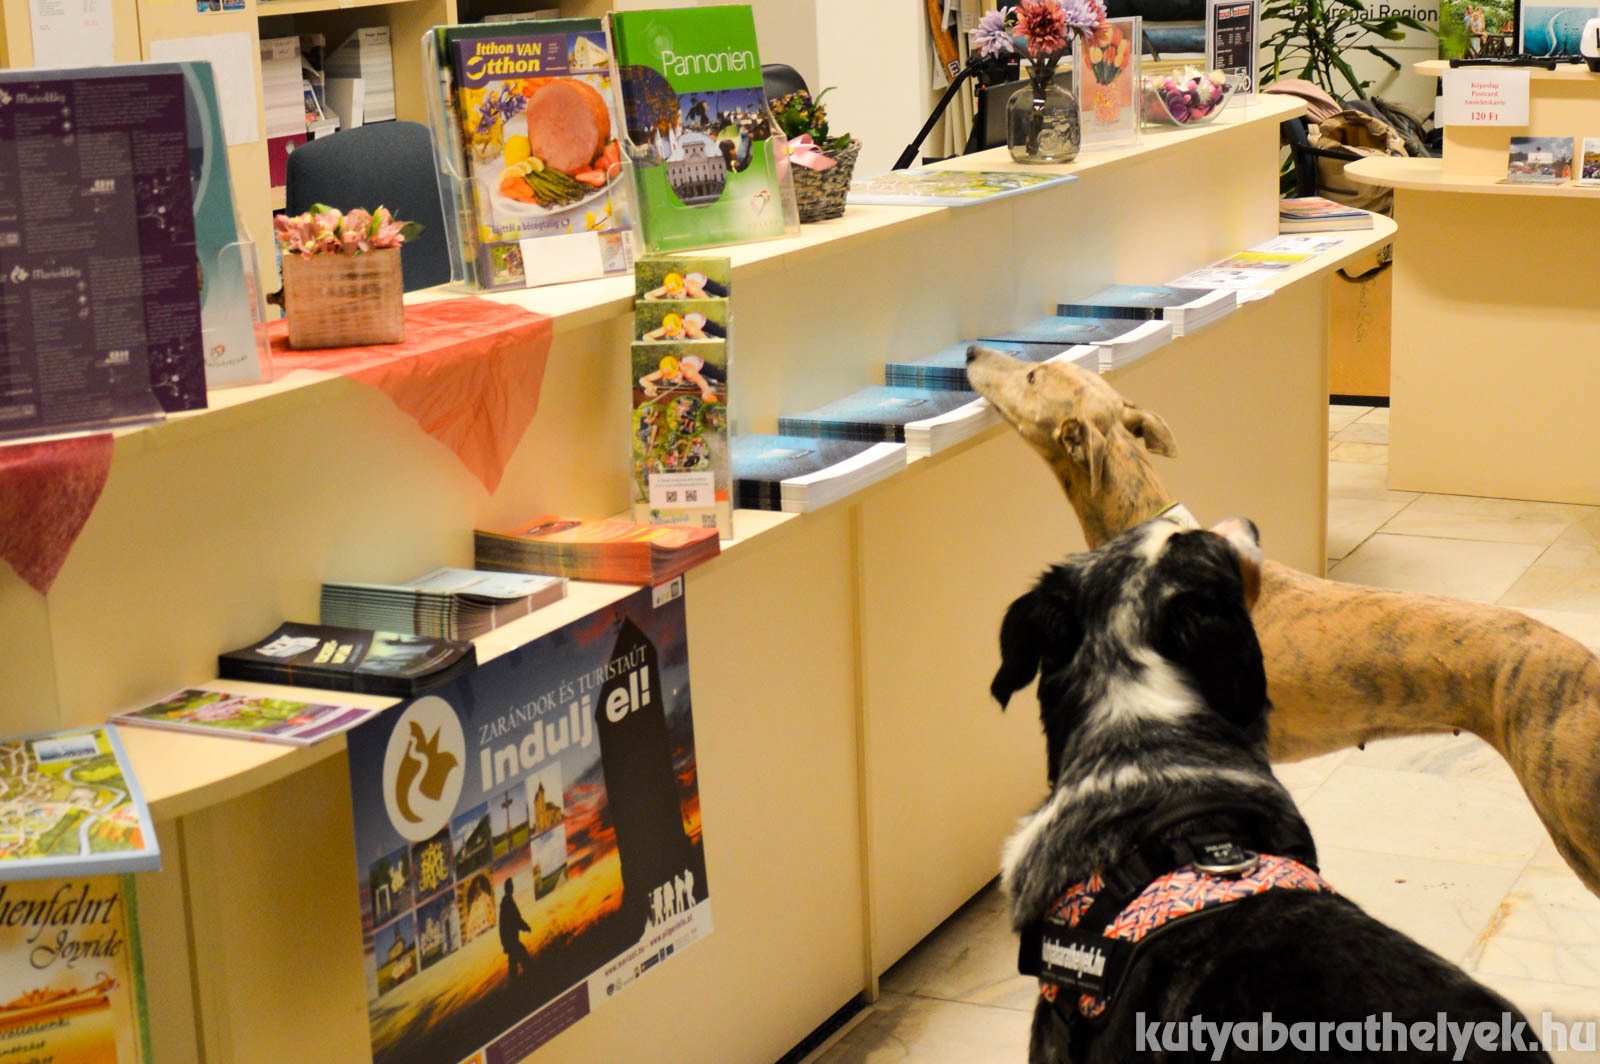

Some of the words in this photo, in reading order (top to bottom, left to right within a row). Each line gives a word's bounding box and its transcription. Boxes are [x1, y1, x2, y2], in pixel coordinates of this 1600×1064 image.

[1379, 4, 1438, 22] Region
[476, 42, 514, 56] Itthon
[516, 42, 542, 56] VAN
[661, 46, 755, 77] Pannonien
[466, 55, 541, 80] Otthon
[1471, 112, 1486, 120] 120
[1488, 112, 1499, 120] Ft
[479, 690, 557, 745] ZARÁNDOK
[559, 676, 575, 702] ÉS
[577, 643, 648, 694] TURISTAÚT
[480, 694, 593, 793] Indulj
[605, 665, 651, 723] el!
[29, 929, 123, 970] Joyride
